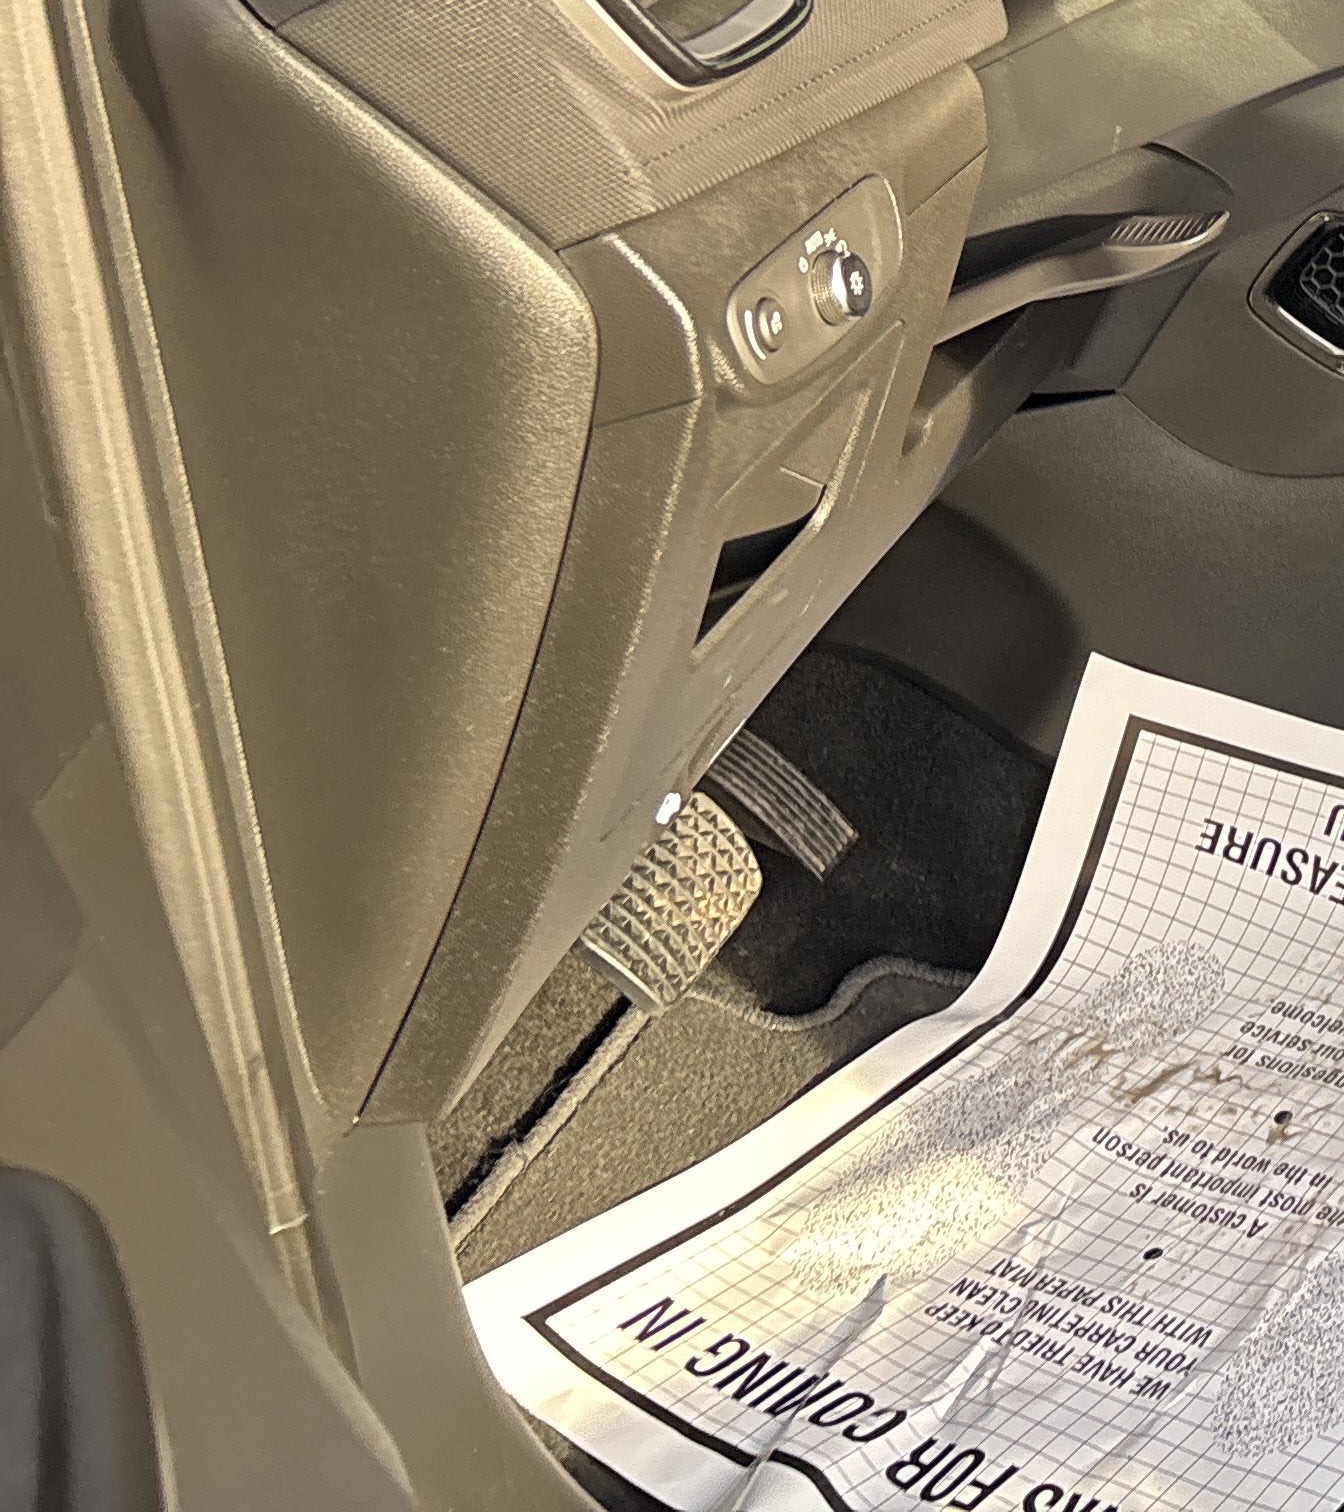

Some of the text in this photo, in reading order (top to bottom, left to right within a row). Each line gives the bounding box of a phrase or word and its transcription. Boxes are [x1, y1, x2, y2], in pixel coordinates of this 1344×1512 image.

[1239, 1020, 1313, 1051] service
[1224, 1044, 1256, 1066] for
[1091, 1126, 1168, 1172] person
[1162, 1126, 1191, 1147] us.
[1191, 1139, 1214, 1158] to
[1211, 1146, 1272, 1175] world
[1273, 1161, 1309, 1187] the
[1160, 1159, 1259, 1204] important
[1150, 1190, 1248, 1231] customer
[1259, 1189, 1317, 1217] most
[1246, 1218, 1269, 1239] A
[986, 1257, 1214, 1348] WITH THIS PAPER MAT
[950, 1276, 1199, 1377] YOUR CARPETING CLEAN
[924, 1302, 1172, 1401] WE HAVE TRIED TO KEEP
[617, 1296, 1021, 1512] FOR COMING IN
